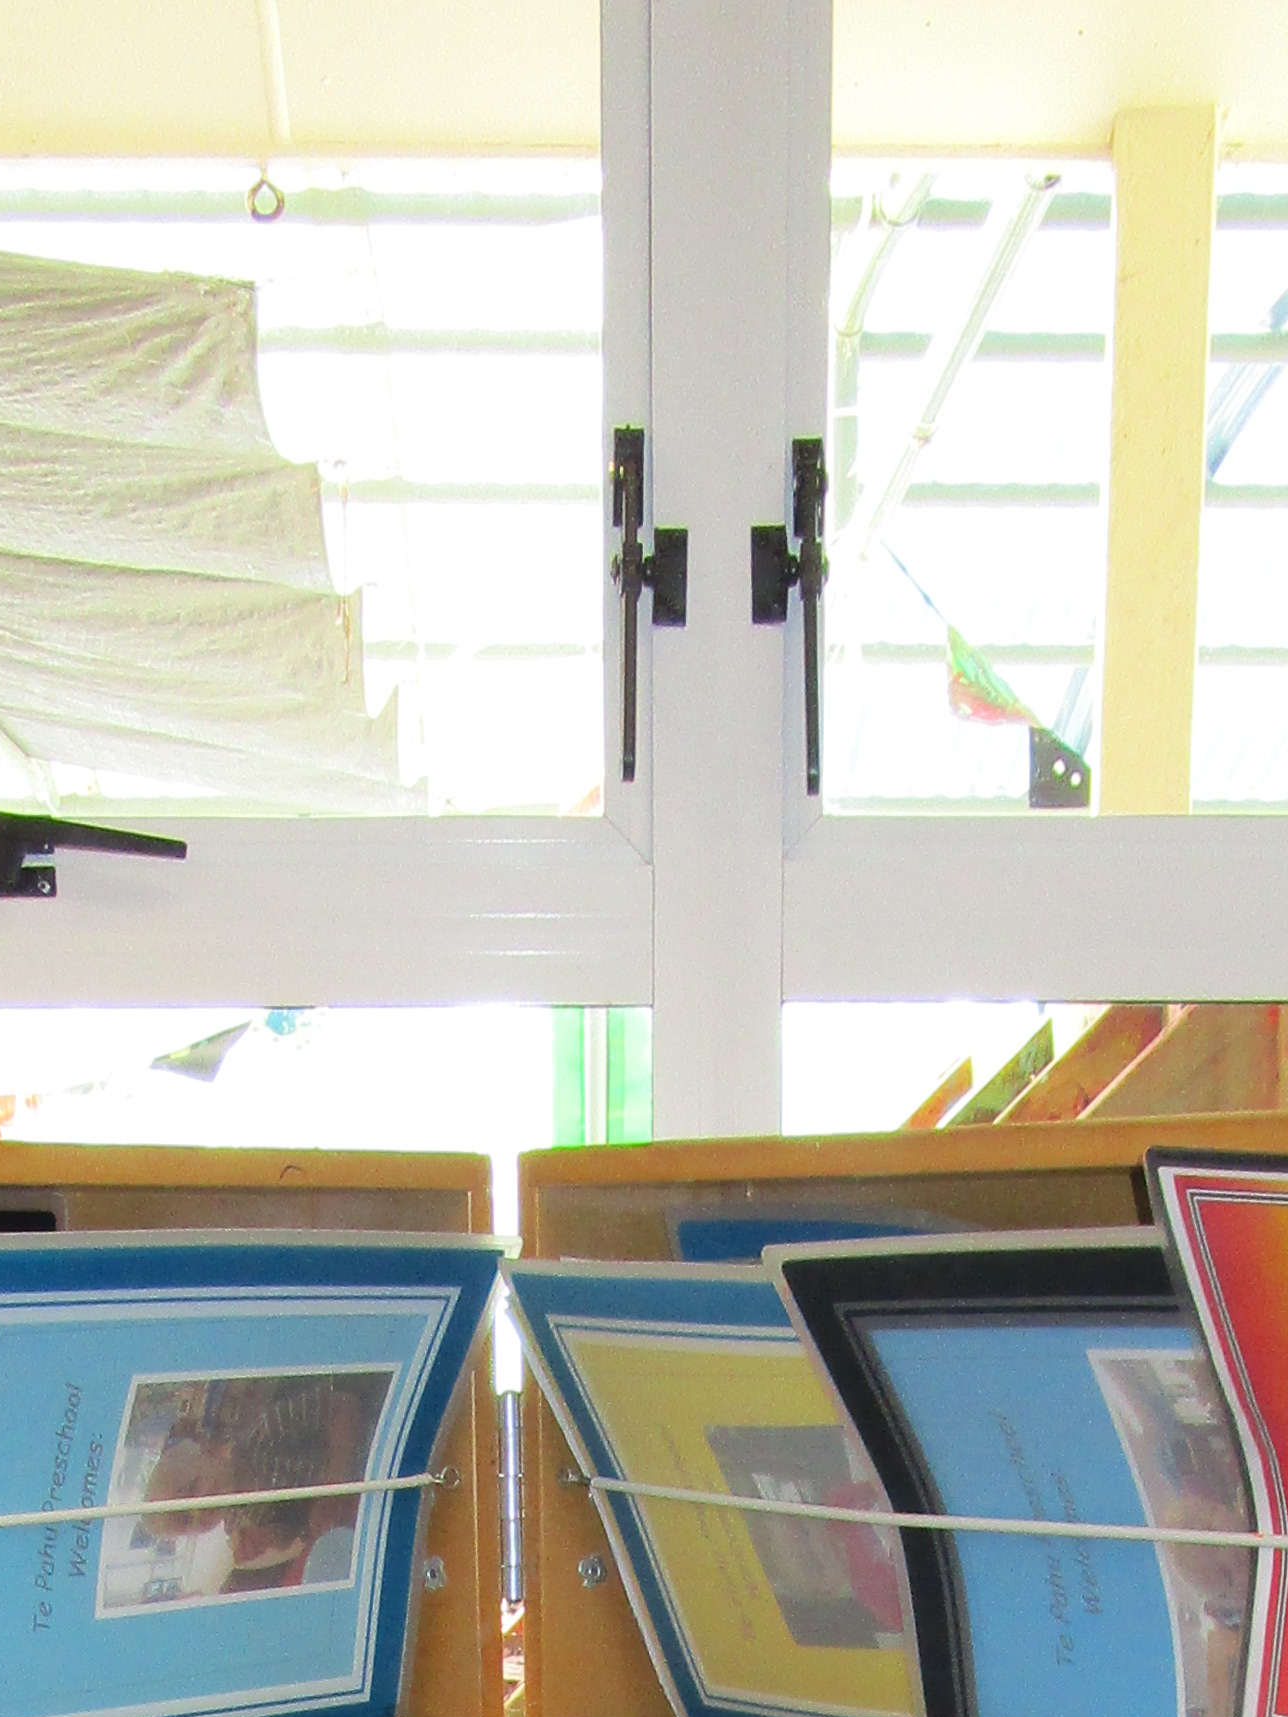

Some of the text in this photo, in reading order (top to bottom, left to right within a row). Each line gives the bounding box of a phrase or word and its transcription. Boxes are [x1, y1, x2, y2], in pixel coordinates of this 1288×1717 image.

[31, 1381, 83, 1633] Te Pahu Preschool
[67, 1432, 104, 1579] Welomes:
